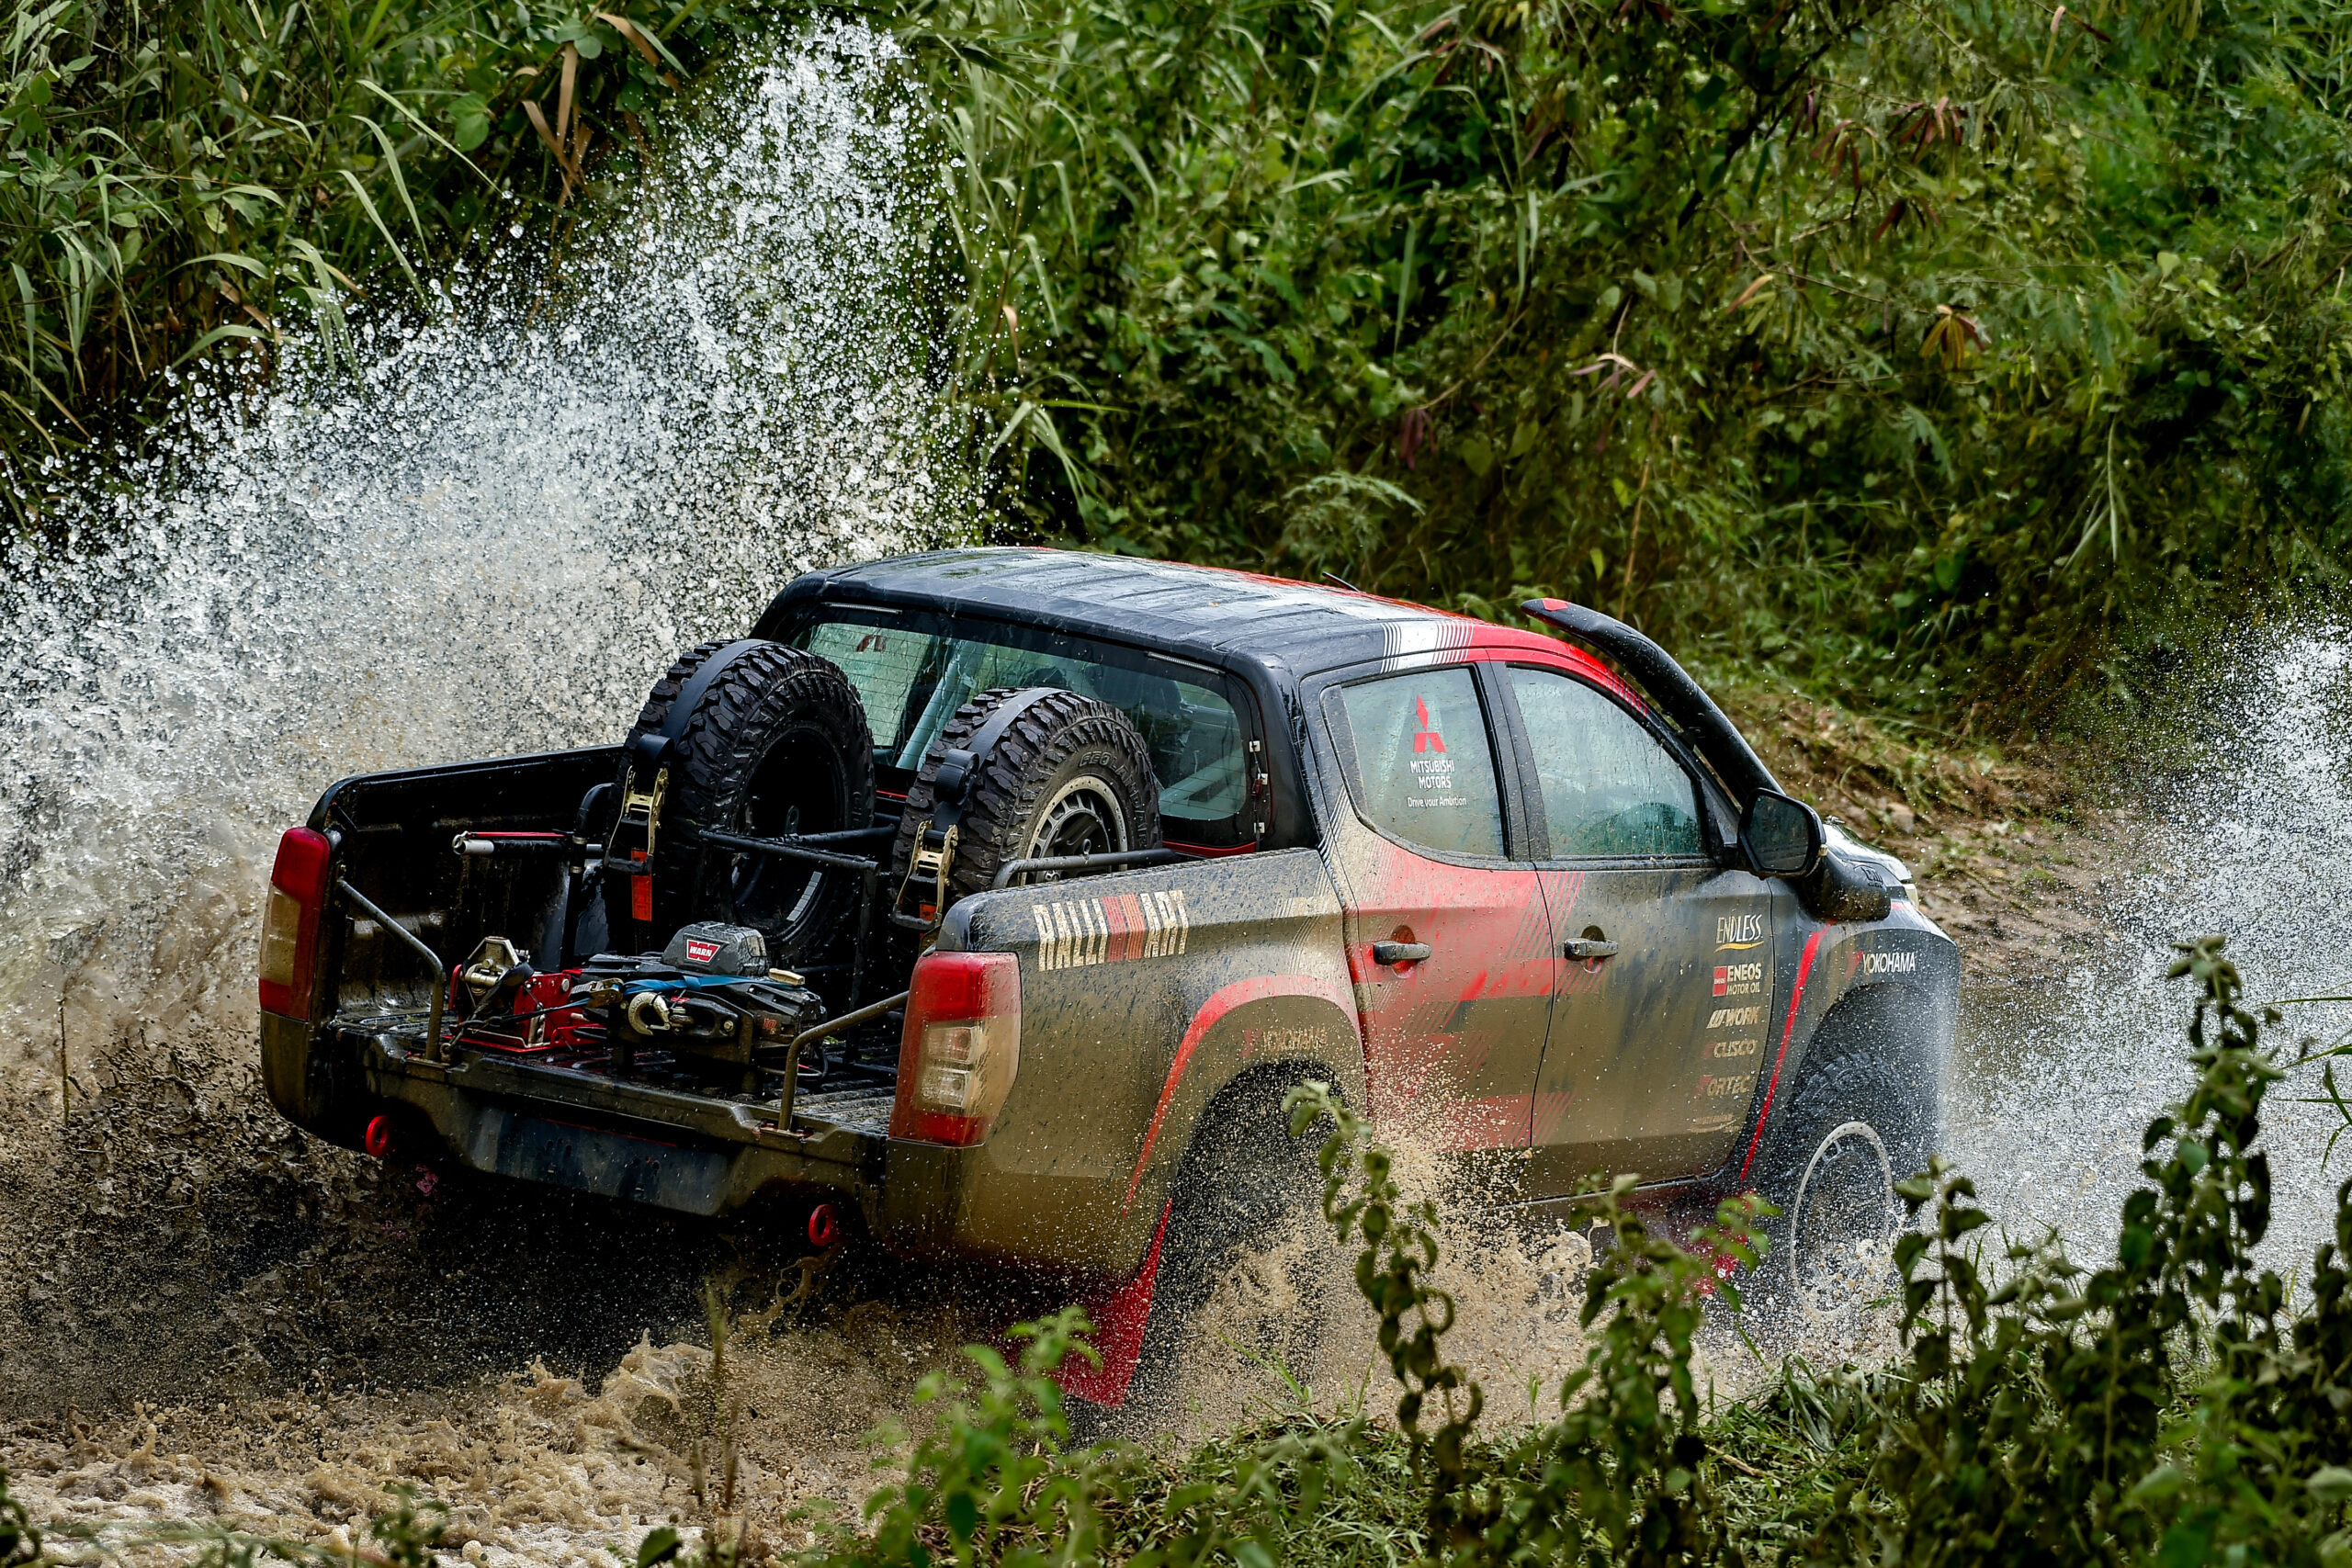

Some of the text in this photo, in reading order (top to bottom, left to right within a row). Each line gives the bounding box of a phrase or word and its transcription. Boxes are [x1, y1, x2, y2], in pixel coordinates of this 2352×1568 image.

[1409, 760, 1455, 773] MITSUBISHI
[1418, 775, 1452, 789] MOTORS
[1407, 795, 1467, 808] Drive your Ambition
[1715, 914, 1764, 944] ENDLESS
[689, 945, 713, 957] WARN
[1862, 952, 1917, 974] YOKOHAMA
[1726, 962, 1762, 982] ENEOS
[1725, 981, 1761, 996] MOTOR OIL
